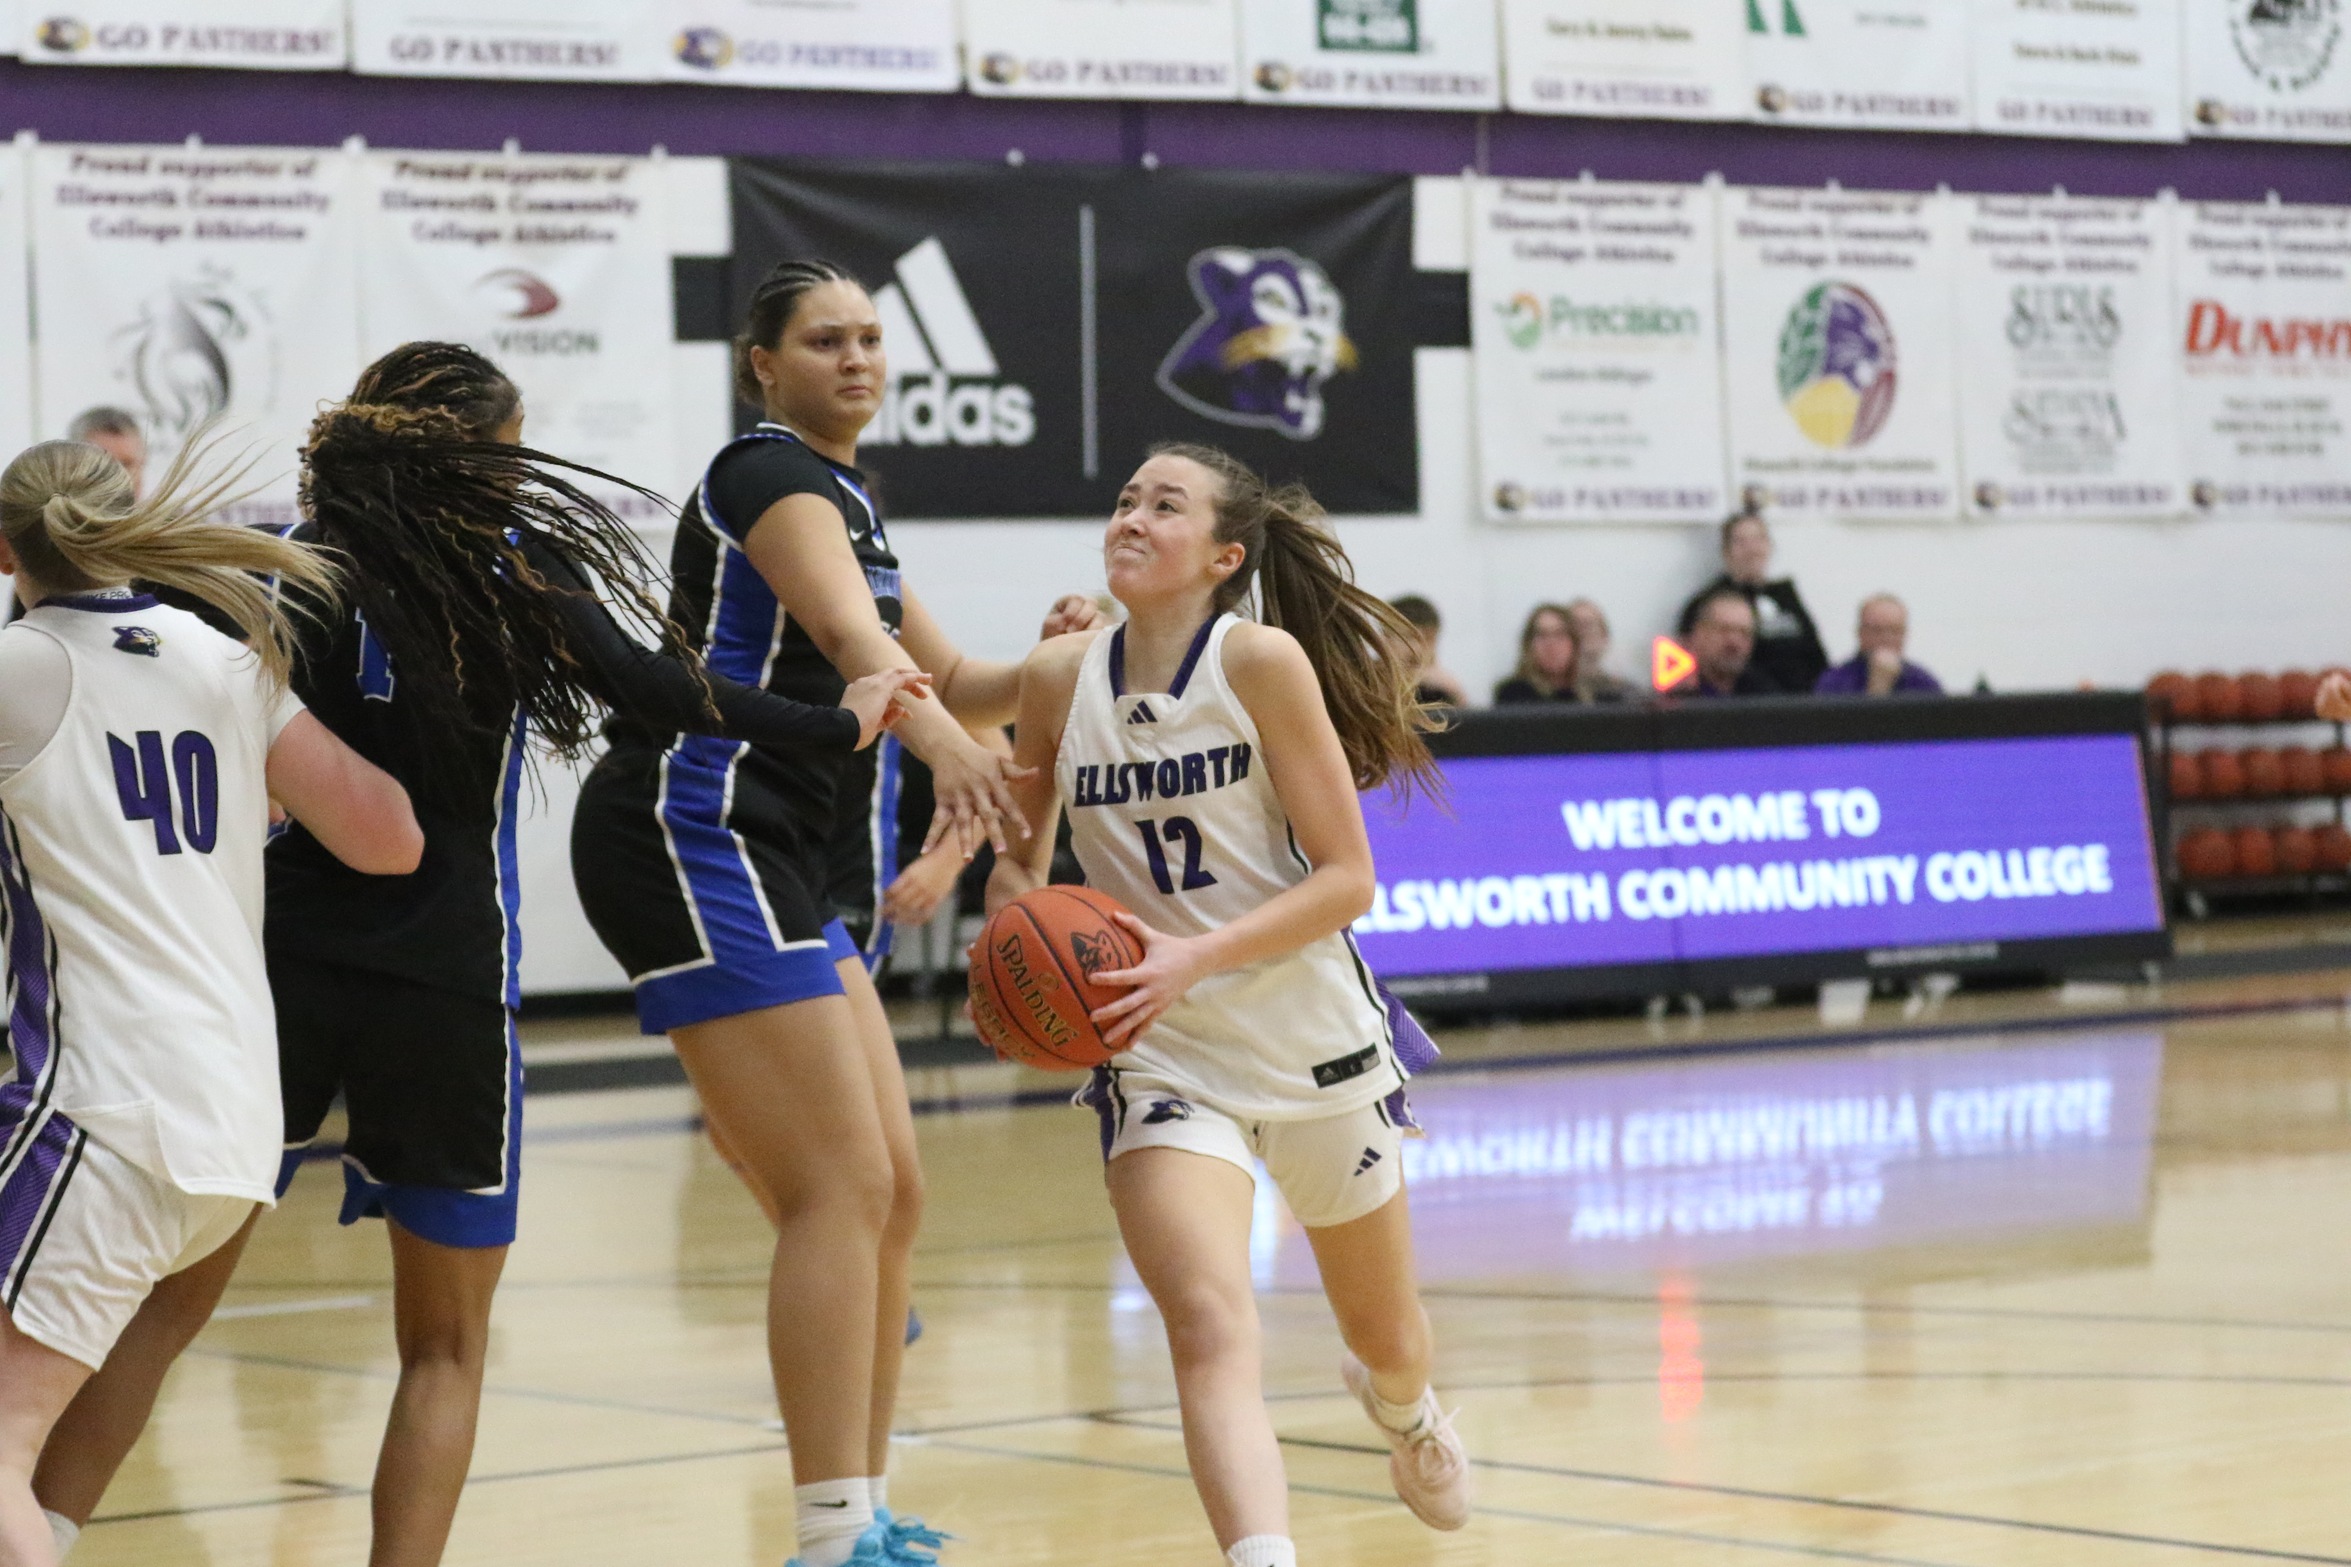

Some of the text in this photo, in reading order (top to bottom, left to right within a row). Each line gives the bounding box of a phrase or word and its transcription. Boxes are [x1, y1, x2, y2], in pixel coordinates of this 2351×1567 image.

[98, 26, 334, 55] GO PANTHERS!
[391, 36, 618, 65] GO PANTHERS!
[1025, 60, 1065, 83] GO
[1299, 68, 1335, 89] GO
[493, 331, 599, 353] VISION
[1551, 294, 1700, 335] Precision
[856, 372, 1036, 446] idas
[106, 730, 219, 856] 40
[1073, 742, 1252, 808] ELLSWORTH
[1560, 786, 1881, 852] WELCOME TO
[1134, 815, 1218, 895] 12
[1351, 842, 2114, 935] LSWORTH COMMUNITY COLLEGE
[997, 932, 1079, 1049] SPALDING
